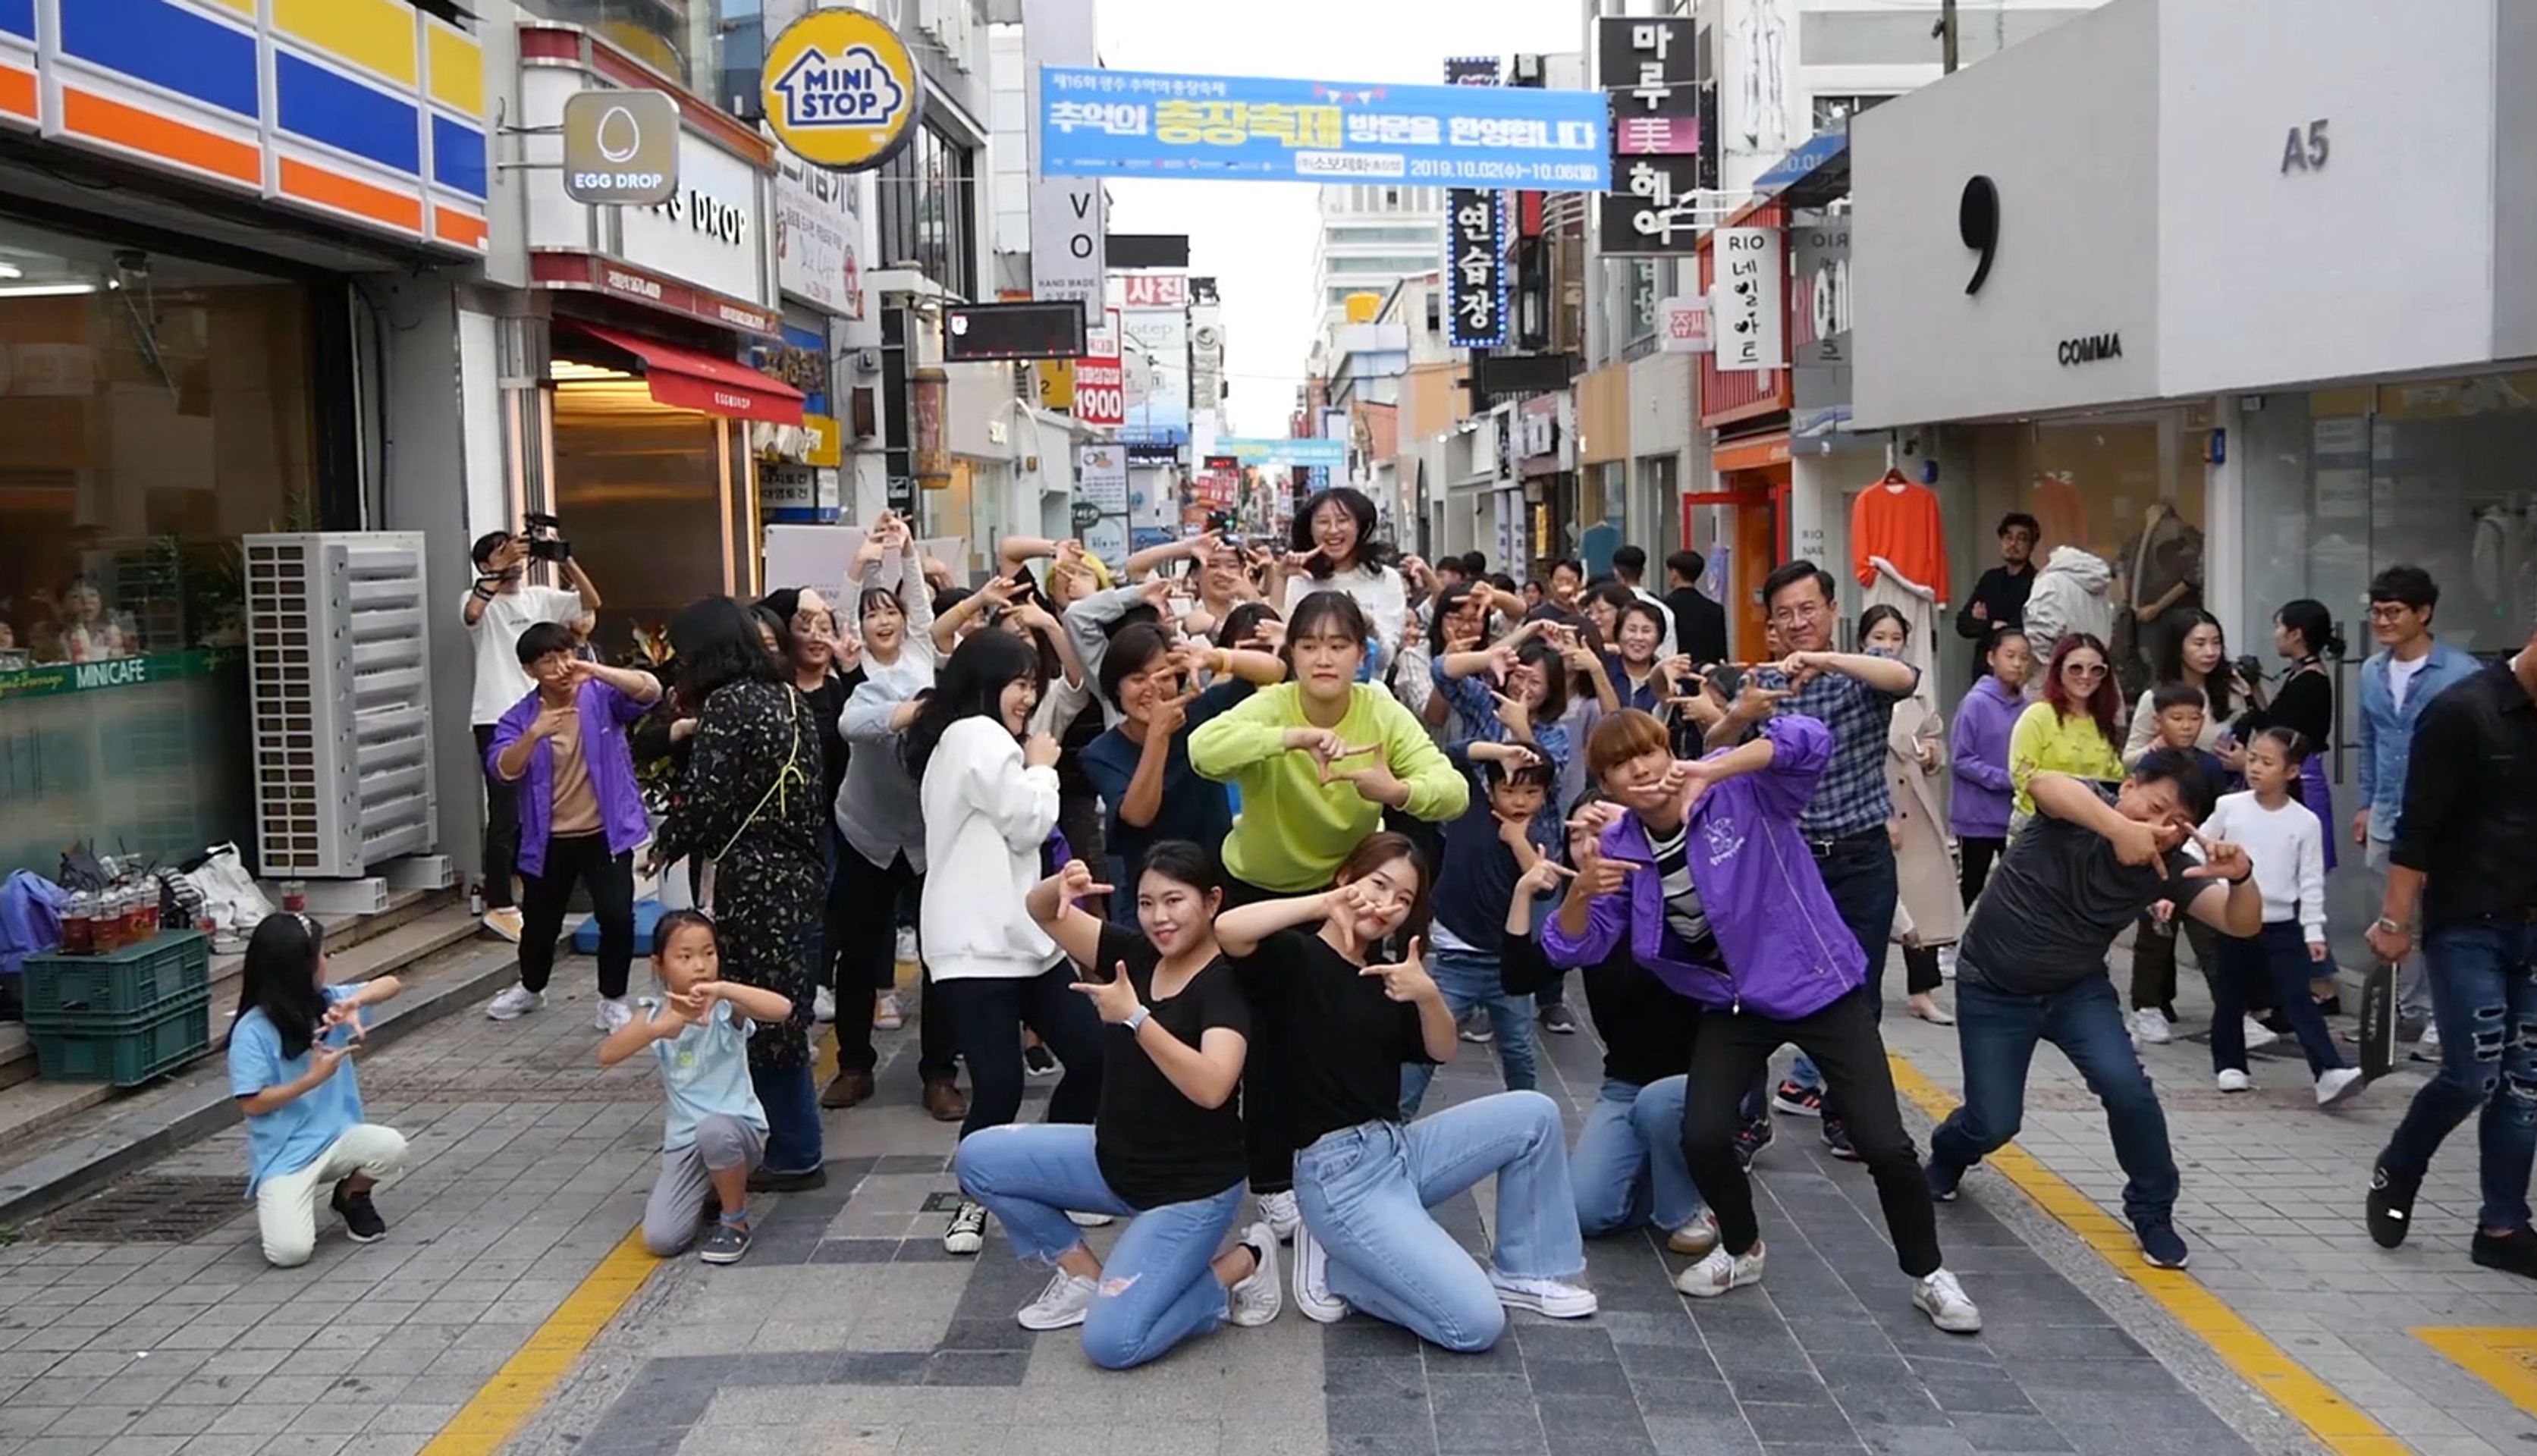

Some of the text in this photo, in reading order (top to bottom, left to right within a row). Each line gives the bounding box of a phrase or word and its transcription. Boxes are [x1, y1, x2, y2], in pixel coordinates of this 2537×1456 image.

[804, 68, 871, 92] MINI
[802, 93, 878, 118] STOP
[1049, 99, 1597, 149] 추억의 충장축제 방문을 환영합니다
[2281, 118, 2329, 174] A5
[574, 173, 663, 190] EGG DROP
[690, 188, 747, 244] DROP
[1070, 193, 1093, 259] VO
[1728, 235, 1765, 251] RIO
[1038, 279, 1095, 288] HAND MADE
[1129, 278, 1183, 303] 사진
[1671, 310, 1706, 338] 쥬씨
[2057, 331, 2123, 366] COMMA
[1076, 389, 1121, 419] 1900
